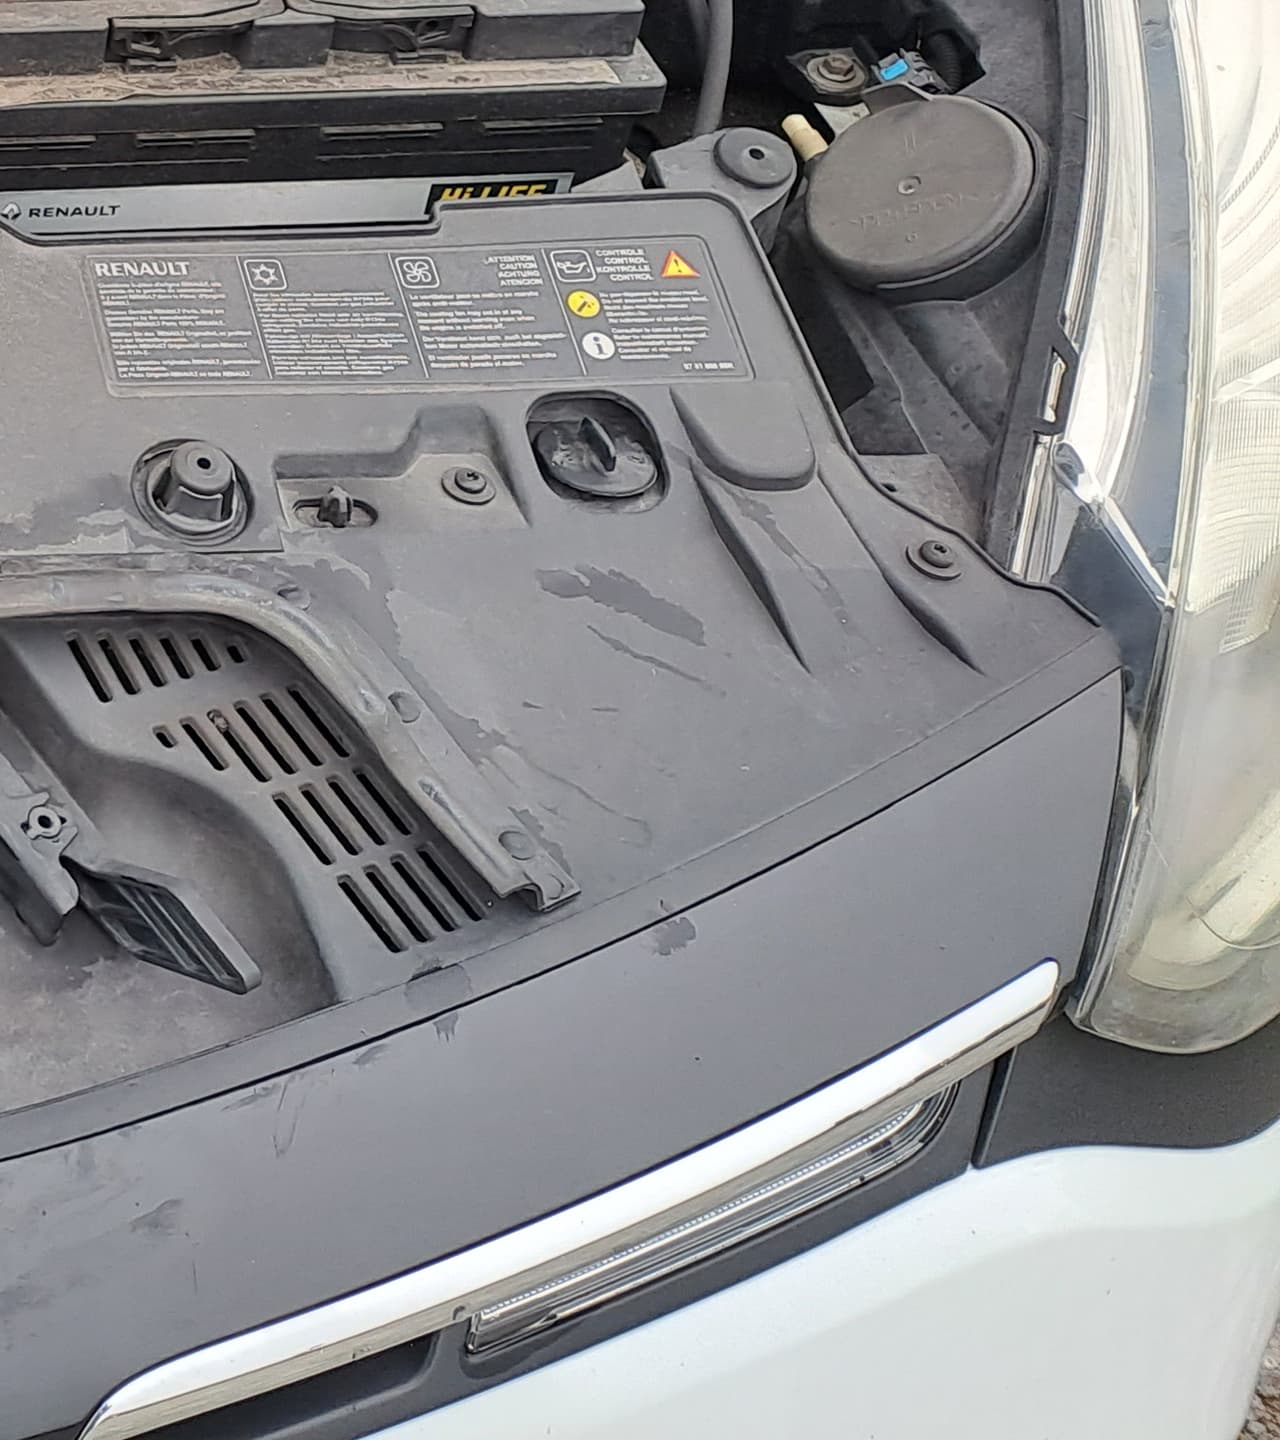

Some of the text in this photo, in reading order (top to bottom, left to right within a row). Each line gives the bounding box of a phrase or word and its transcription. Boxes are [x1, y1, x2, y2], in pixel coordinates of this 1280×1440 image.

[29, 204, 121, 218] RENAULT
[487, 254, 535, 264] ATTENTION
[95, 261, 189, 277] RENAULT
[499, 262, 538, 270] CAUTION
[497, 270, 541, 278] ACHTUNG
